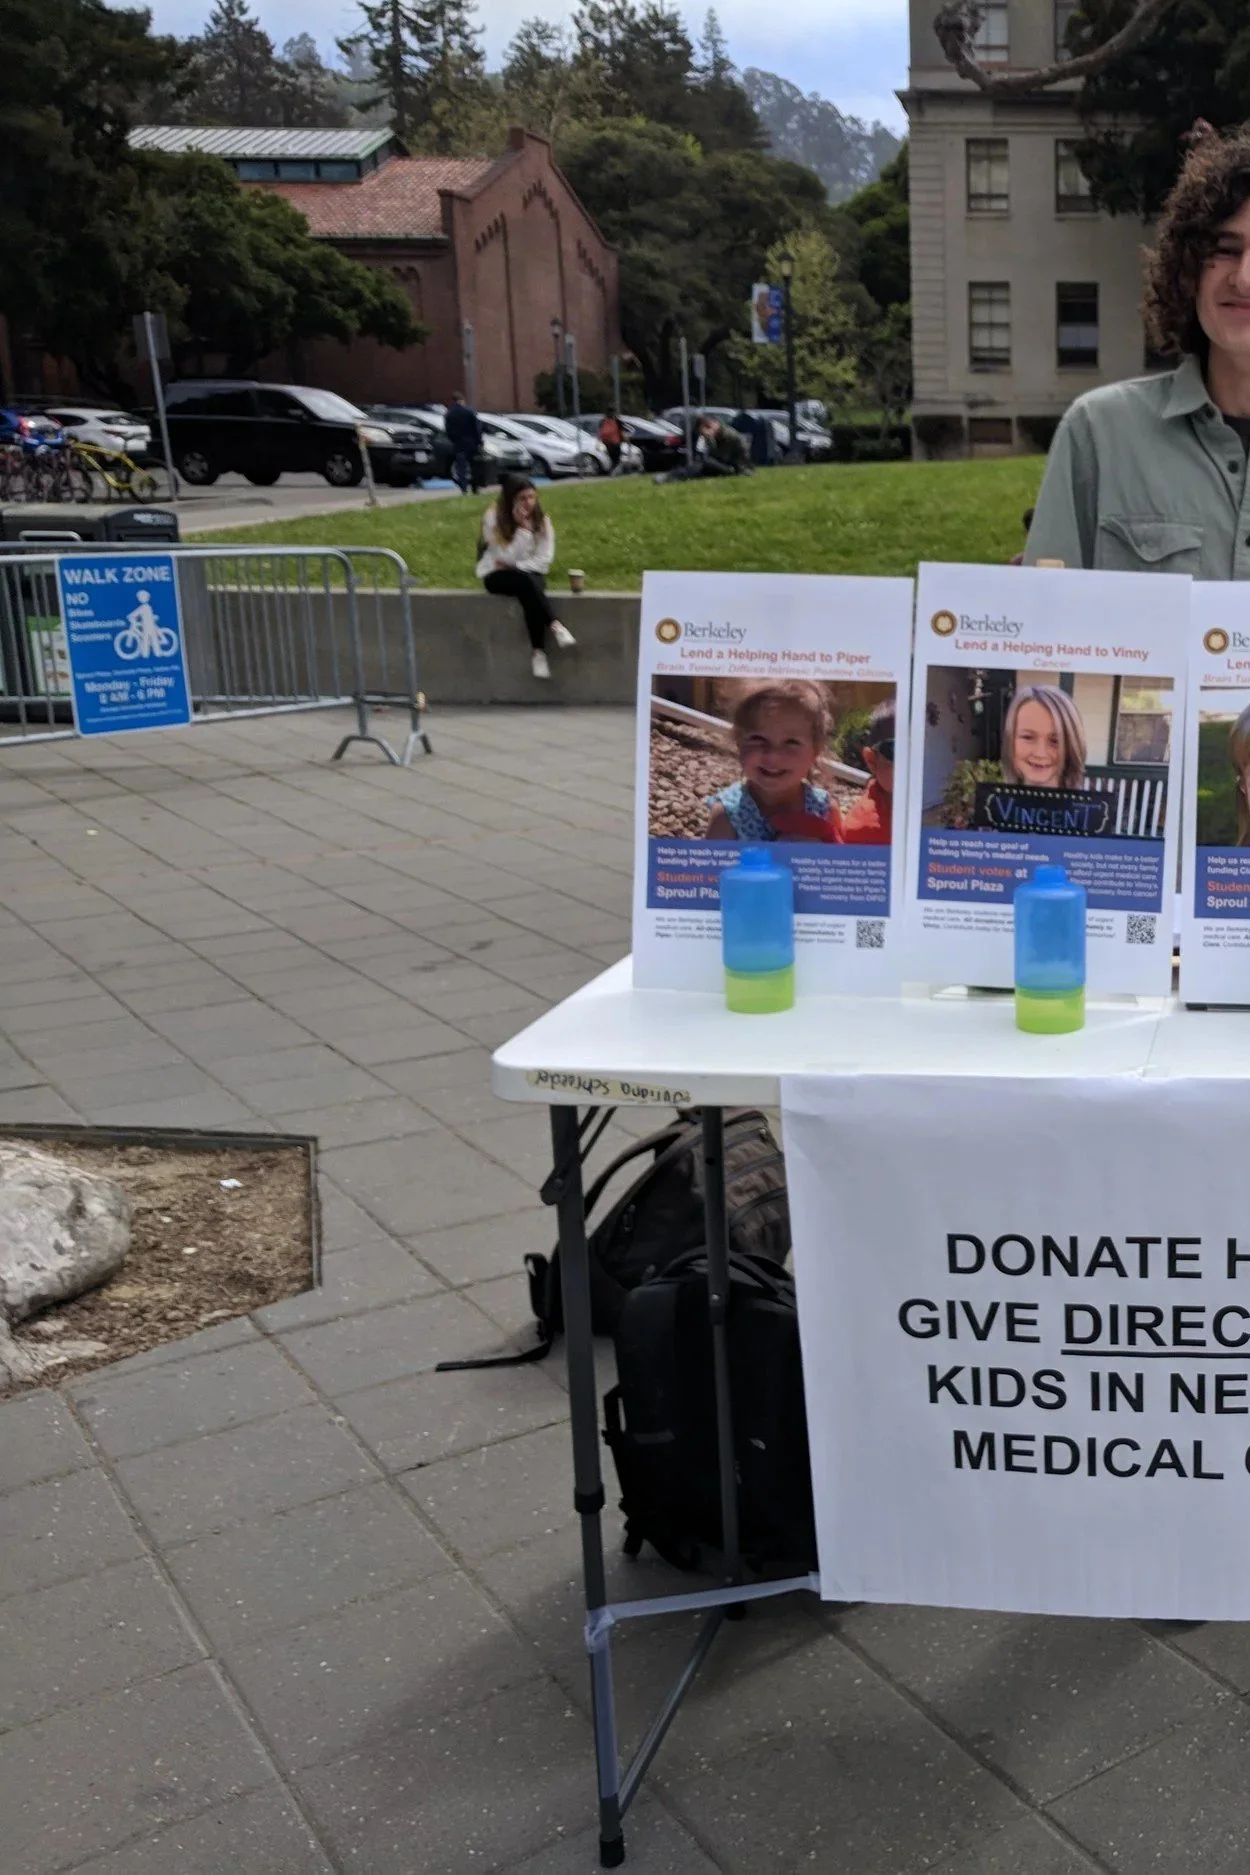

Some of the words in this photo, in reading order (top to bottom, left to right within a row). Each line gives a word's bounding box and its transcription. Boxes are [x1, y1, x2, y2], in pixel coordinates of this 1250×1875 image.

[63, 568, 119, 585] WALK
[121, 565, 172, 582] ZONE
[65, 592, 89, 605] NO
[683, 621, 747, 643] Berkeley
[960, 615, 1023, 638] Berkeley
[680, 647, 712, 659] Lend
[716, 651, 724, 659] a
[728, 648, 778, 663] Helping
[781, 650, 815, 662] Hand
[820, 652, 832, 662] to
[837, 652, 870, 666] Piper
[955, 639, 987, 650] Lend
[992, 643, 999, 651] a
[1003, 641, 1053, 656] Helping
[1057, 644, 1091, 656] Hand
[1096, 646, 1108, 657] to
[1112, 647, 1148, 661] Vinny
[1033, 658, 1070, 668] Cancer
[85, 681, 129, 693] Monday
[139, 676, 174, 687] Friday
[929, 838, 947, 846] Help
[1001, 842, 1018, 851] goal
[1207, 856, 1226, 864] Help
[657, 871, 704, 883] Student
[928, 863, 975, 875] Student
[979, 868, 1012, 877] votes
[1015, 868, 1027, 878] at
[1207, 866, 1238, 875] funding
[657, 885, 696, 899] Sproul
[928, 877, 968, 890] Sproul
[971, 880, 1004, 892] Plaza
[1207, 896, 1247, 909] Sproul
[946, 1233, 1202, 1280] DONATE
[898, 1298, 1041, 1344] GIVE
[927, 1364, 1067, 1411] KIDS
[1090, 1371, 1144, 1413] IN
[953, 1429, 1225, 1480] MEDICAL
